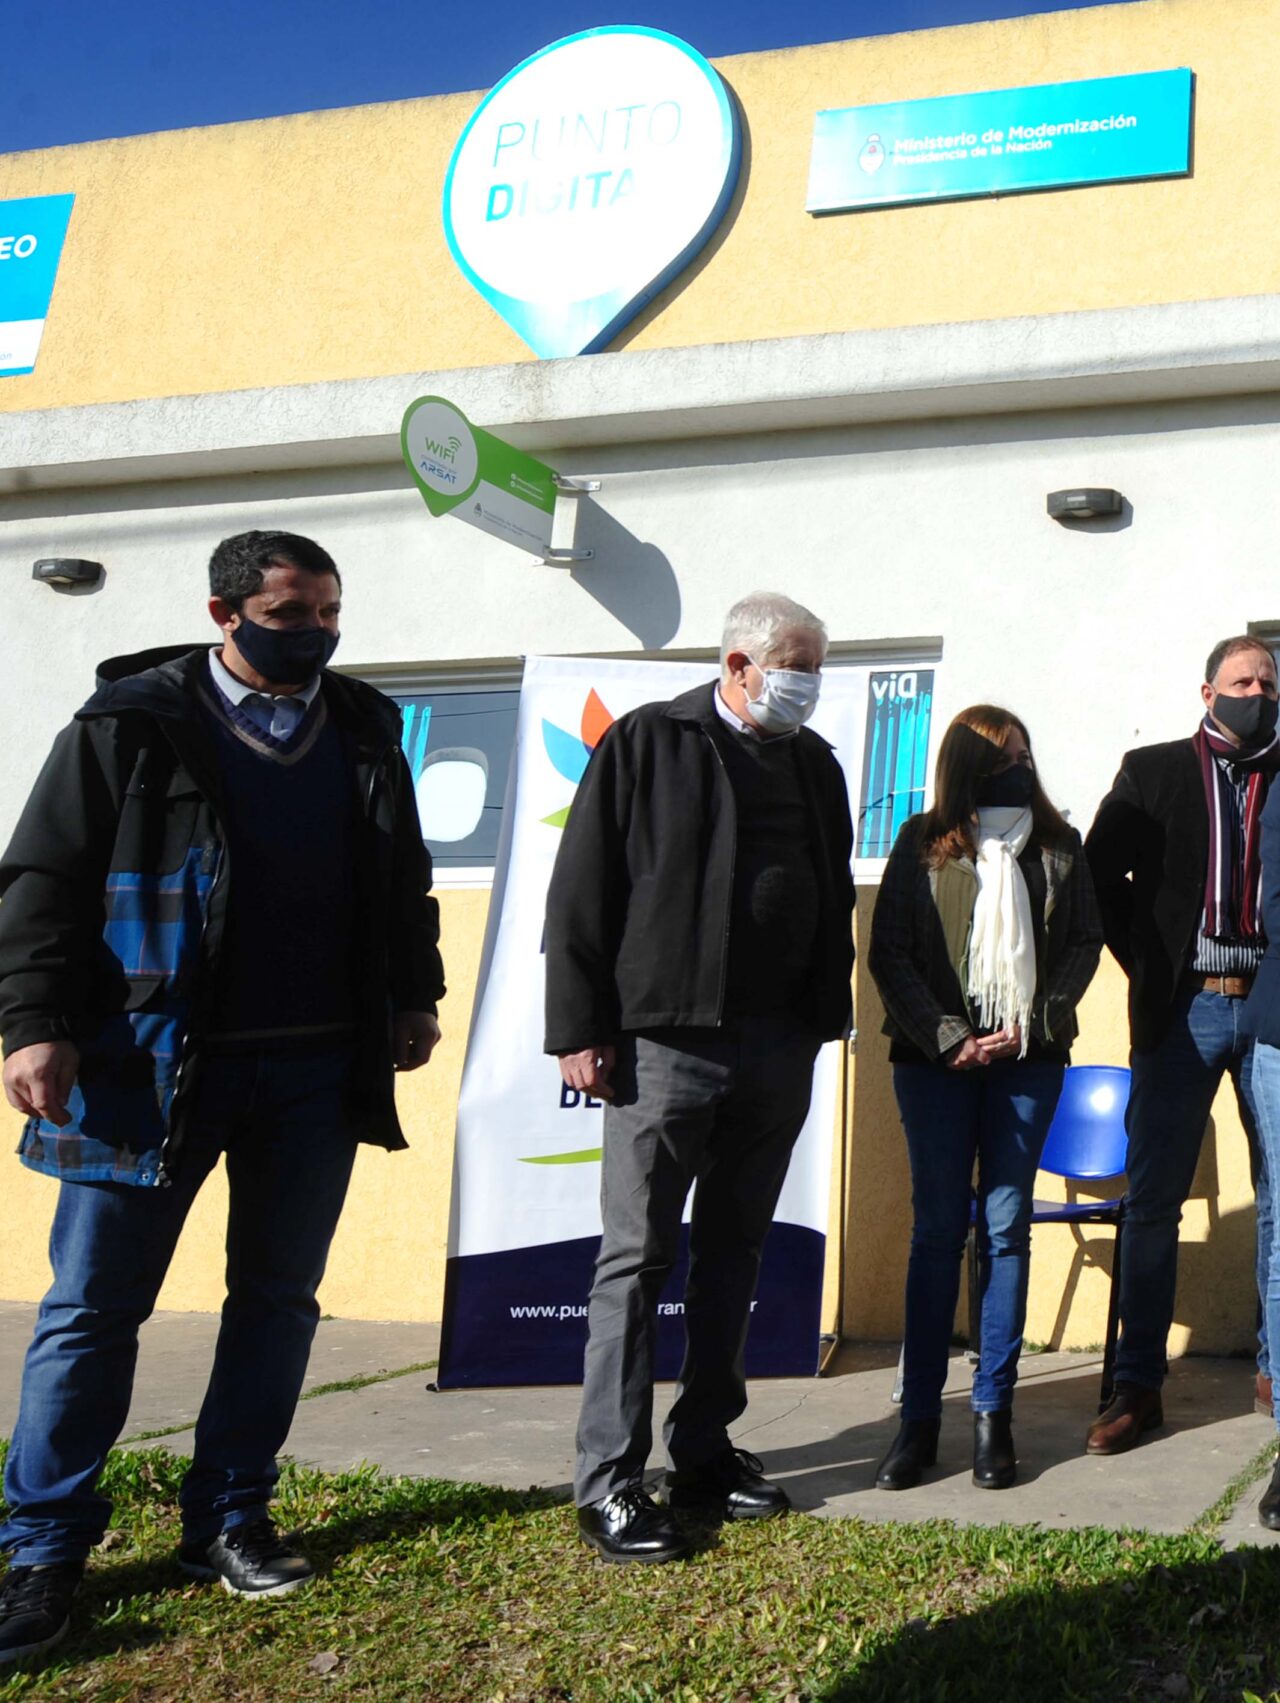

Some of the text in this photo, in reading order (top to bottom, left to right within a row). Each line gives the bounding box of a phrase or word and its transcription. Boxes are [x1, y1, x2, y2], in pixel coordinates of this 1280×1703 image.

[493, 100, 682, 168] PUNTO
[894, 114, 1138, 151] Ministerio de Modernización
[970, 146, 987, 158] de
[991, 144, 1003, 155] la
[1005, 138, 1053, 153] Nación
[486, 167, 636, 222] DIGITA
[0, 234, 38, 260] EO
[420, 461, 456, 485] ARSAT
[510, 1304, 588, 1320] www.pue
[657, 1301, 685, 1315] ran
